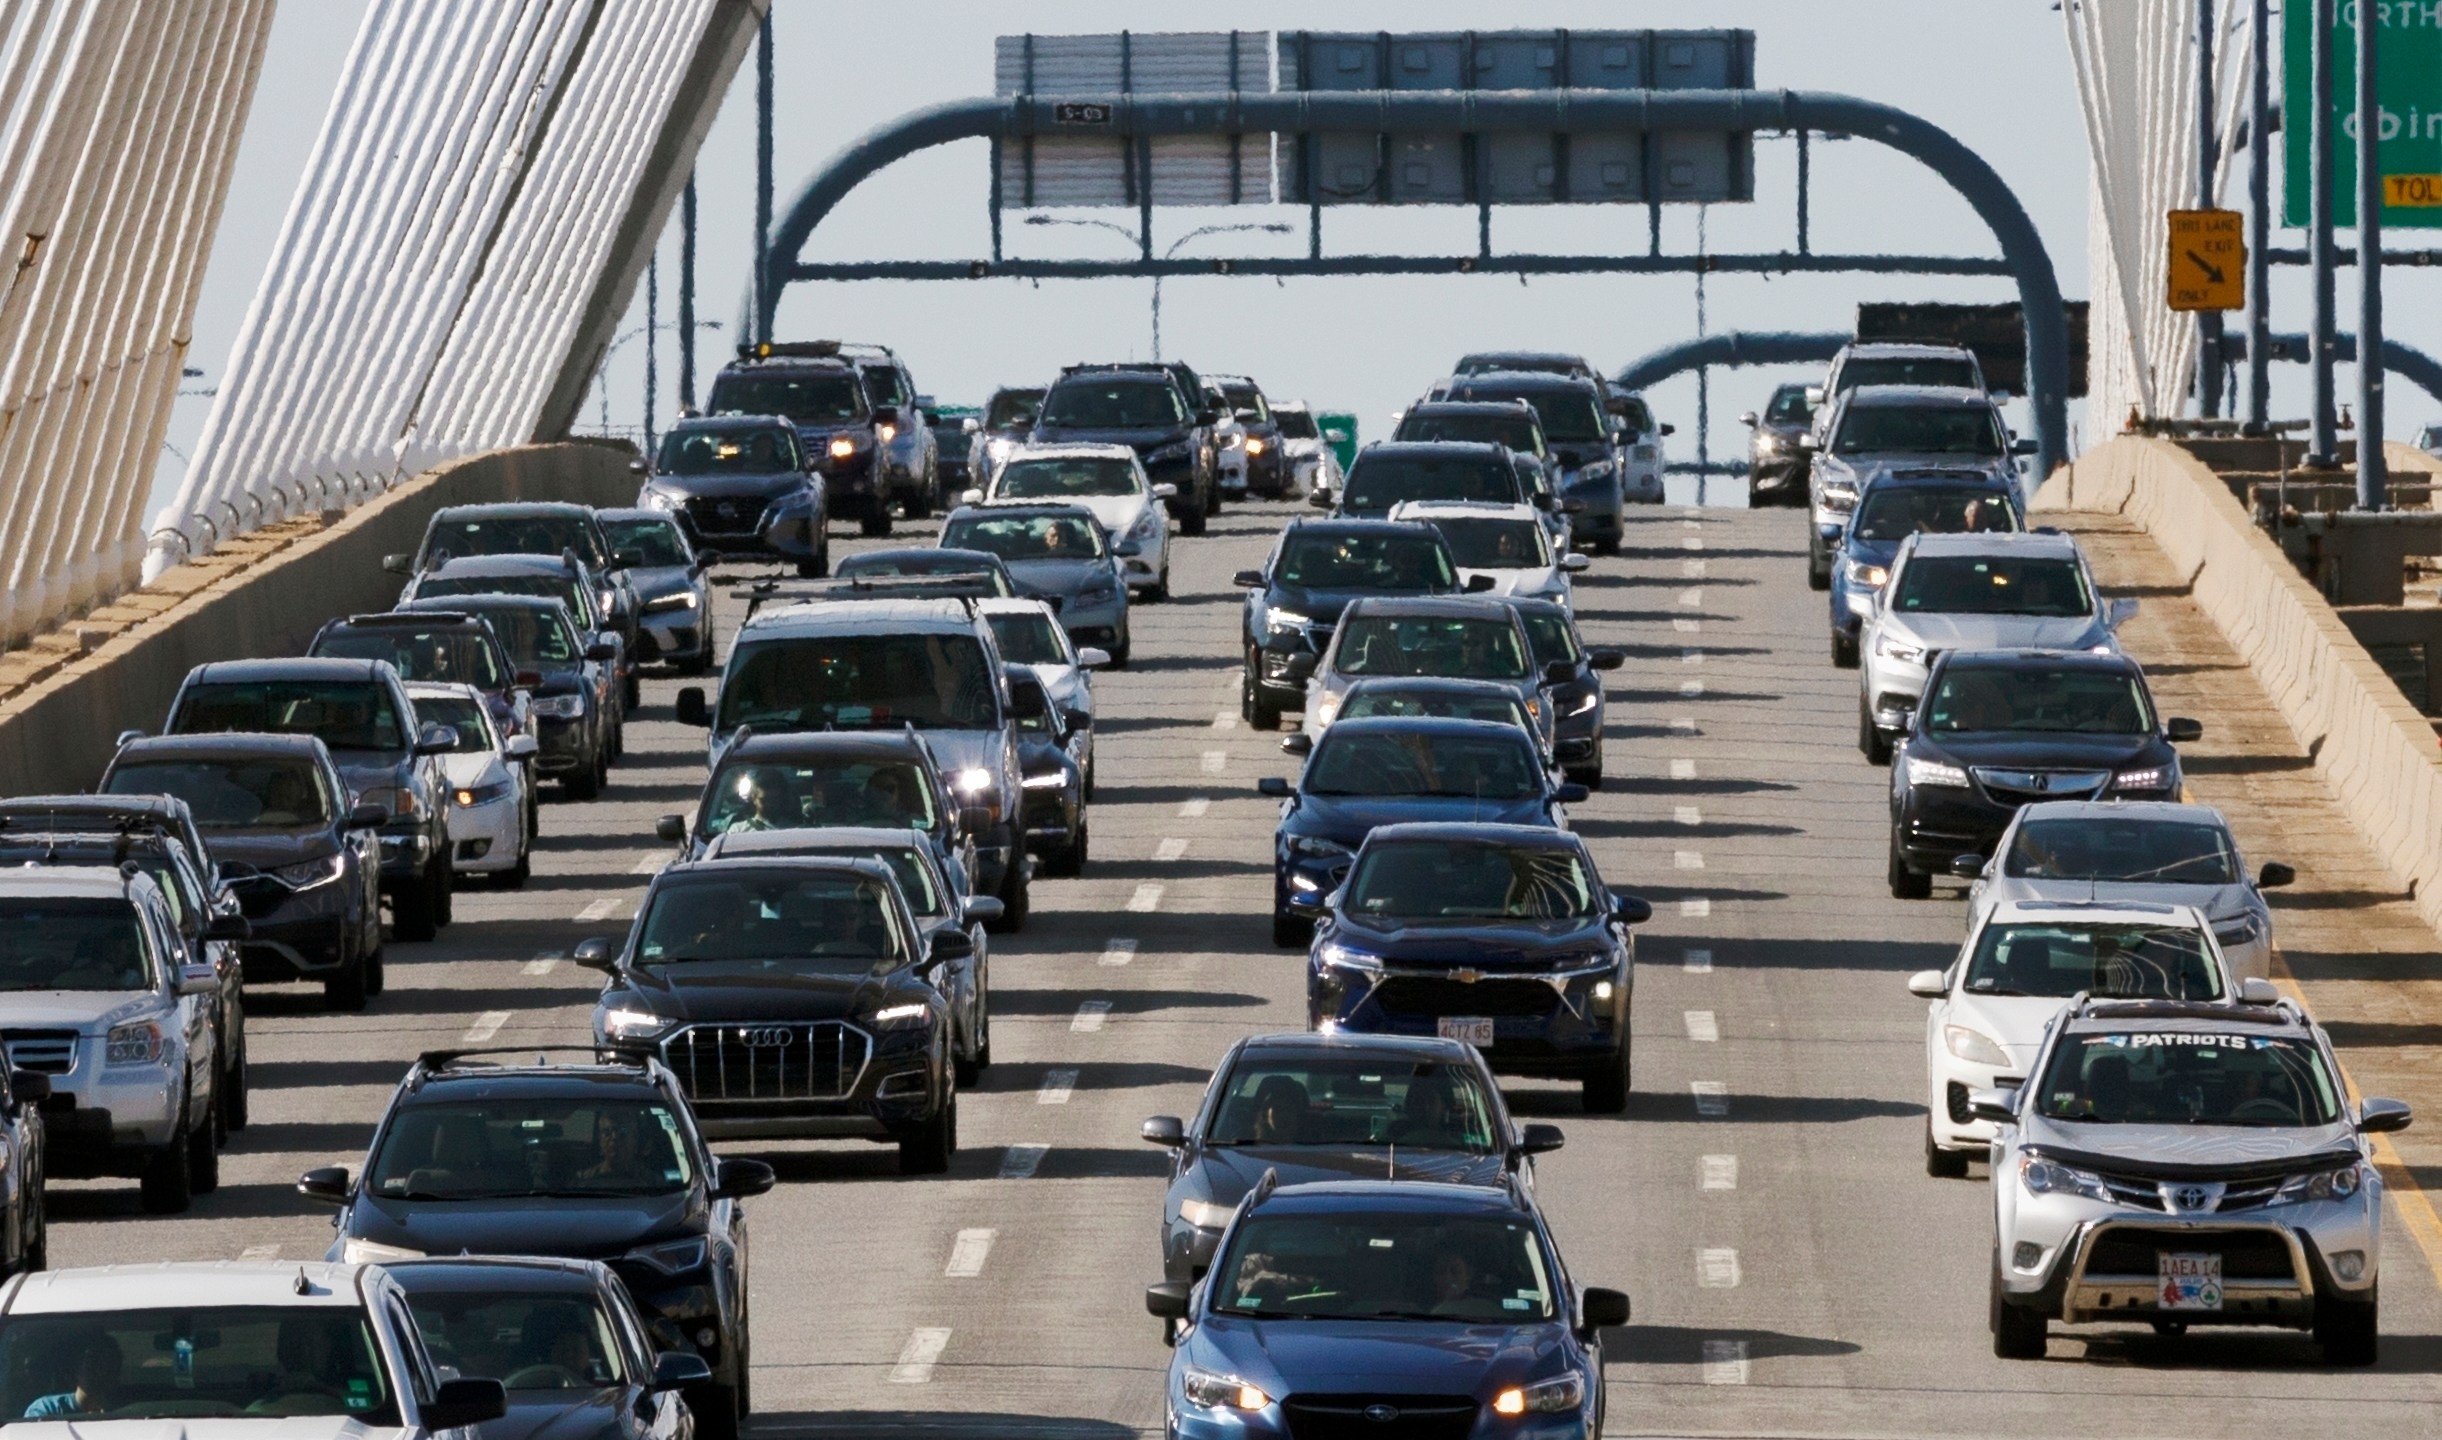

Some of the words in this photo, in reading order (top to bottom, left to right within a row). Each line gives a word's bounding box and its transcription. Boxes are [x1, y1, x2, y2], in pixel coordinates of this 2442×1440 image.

[2332, 103, 2442, 141] obin
[2131, 1033, 2247, 1049] PATRIOTS
[2161, 1258, 2198, 1276] 1AEA
[2203, 1259, 2220, 1276] 14
